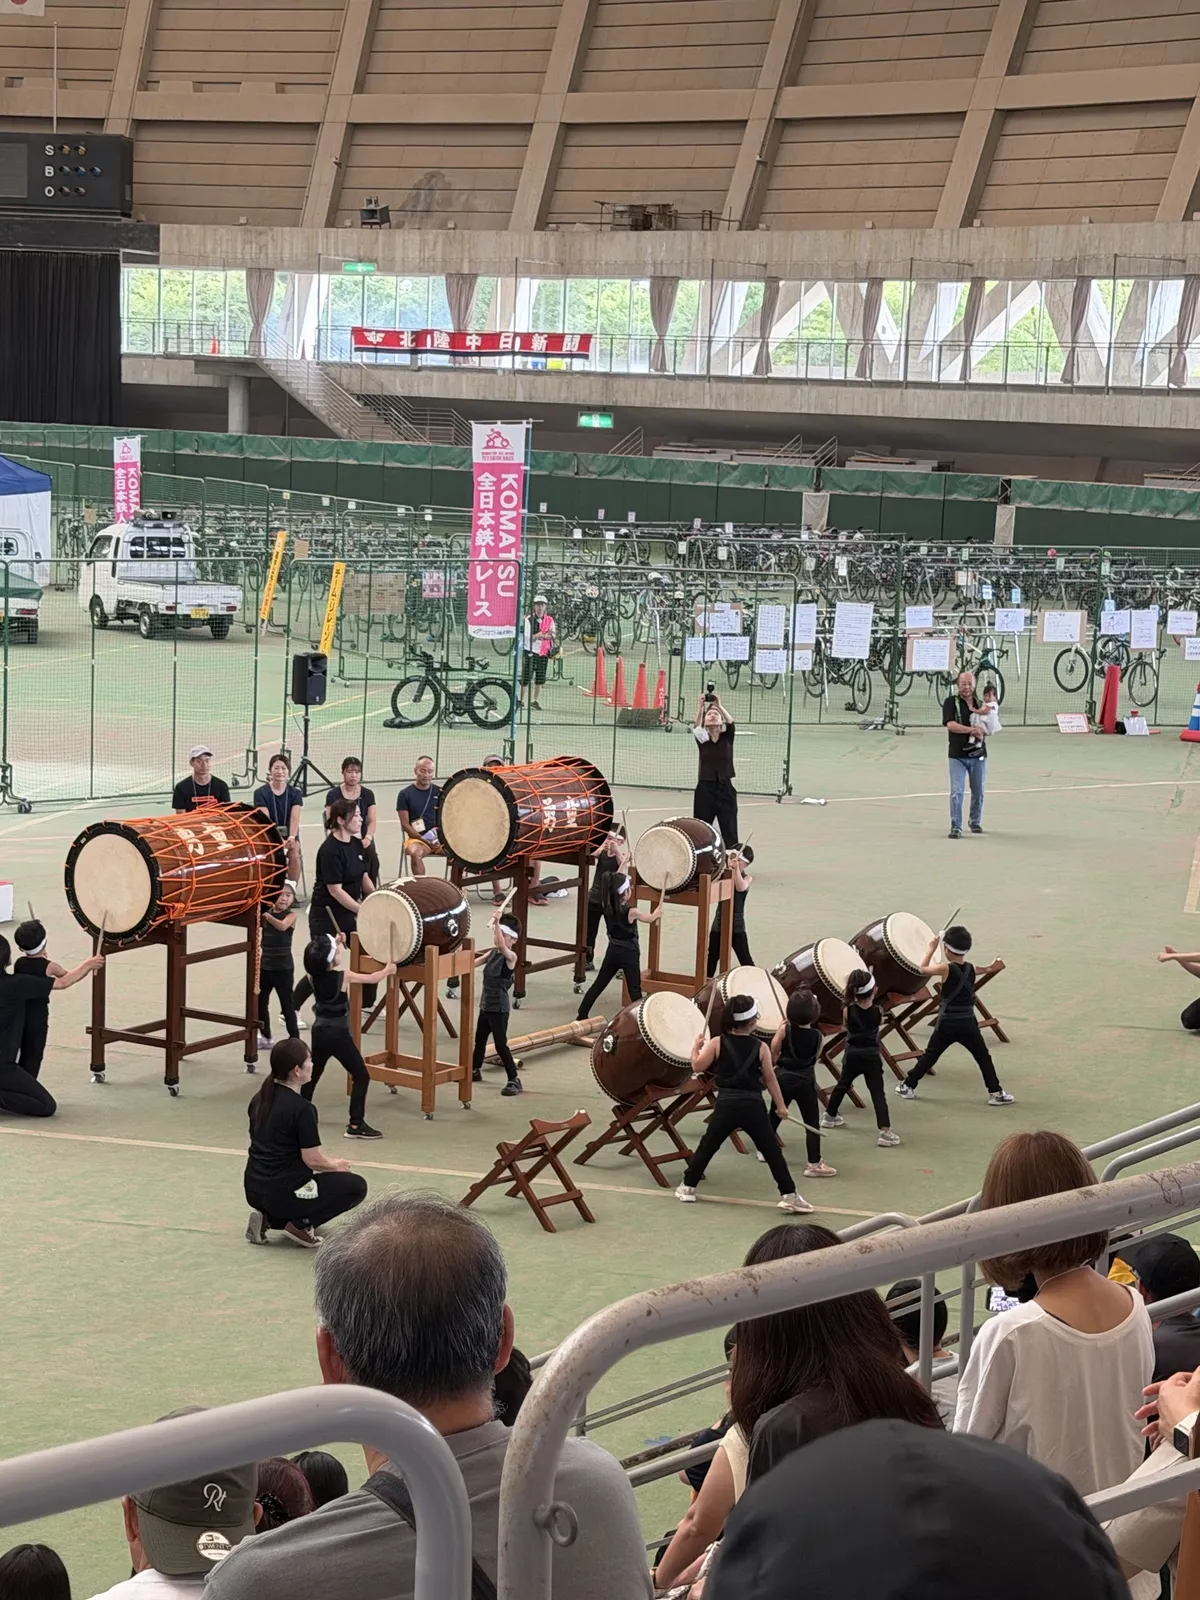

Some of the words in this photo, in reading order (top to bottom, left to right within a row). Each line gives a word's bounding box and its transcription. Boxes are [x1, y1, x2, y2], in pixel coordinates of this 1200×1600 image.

[44, 144, 54, 156] S
[44, 165, 54, 177] B
[399, 330, 580, 352] 北陸中日新聞
[127, 467, 140, 519] KOMA
[473, 471, 497, 617] 全日本鉄人レース
[497, 473, 519, 597] KOMATSU
